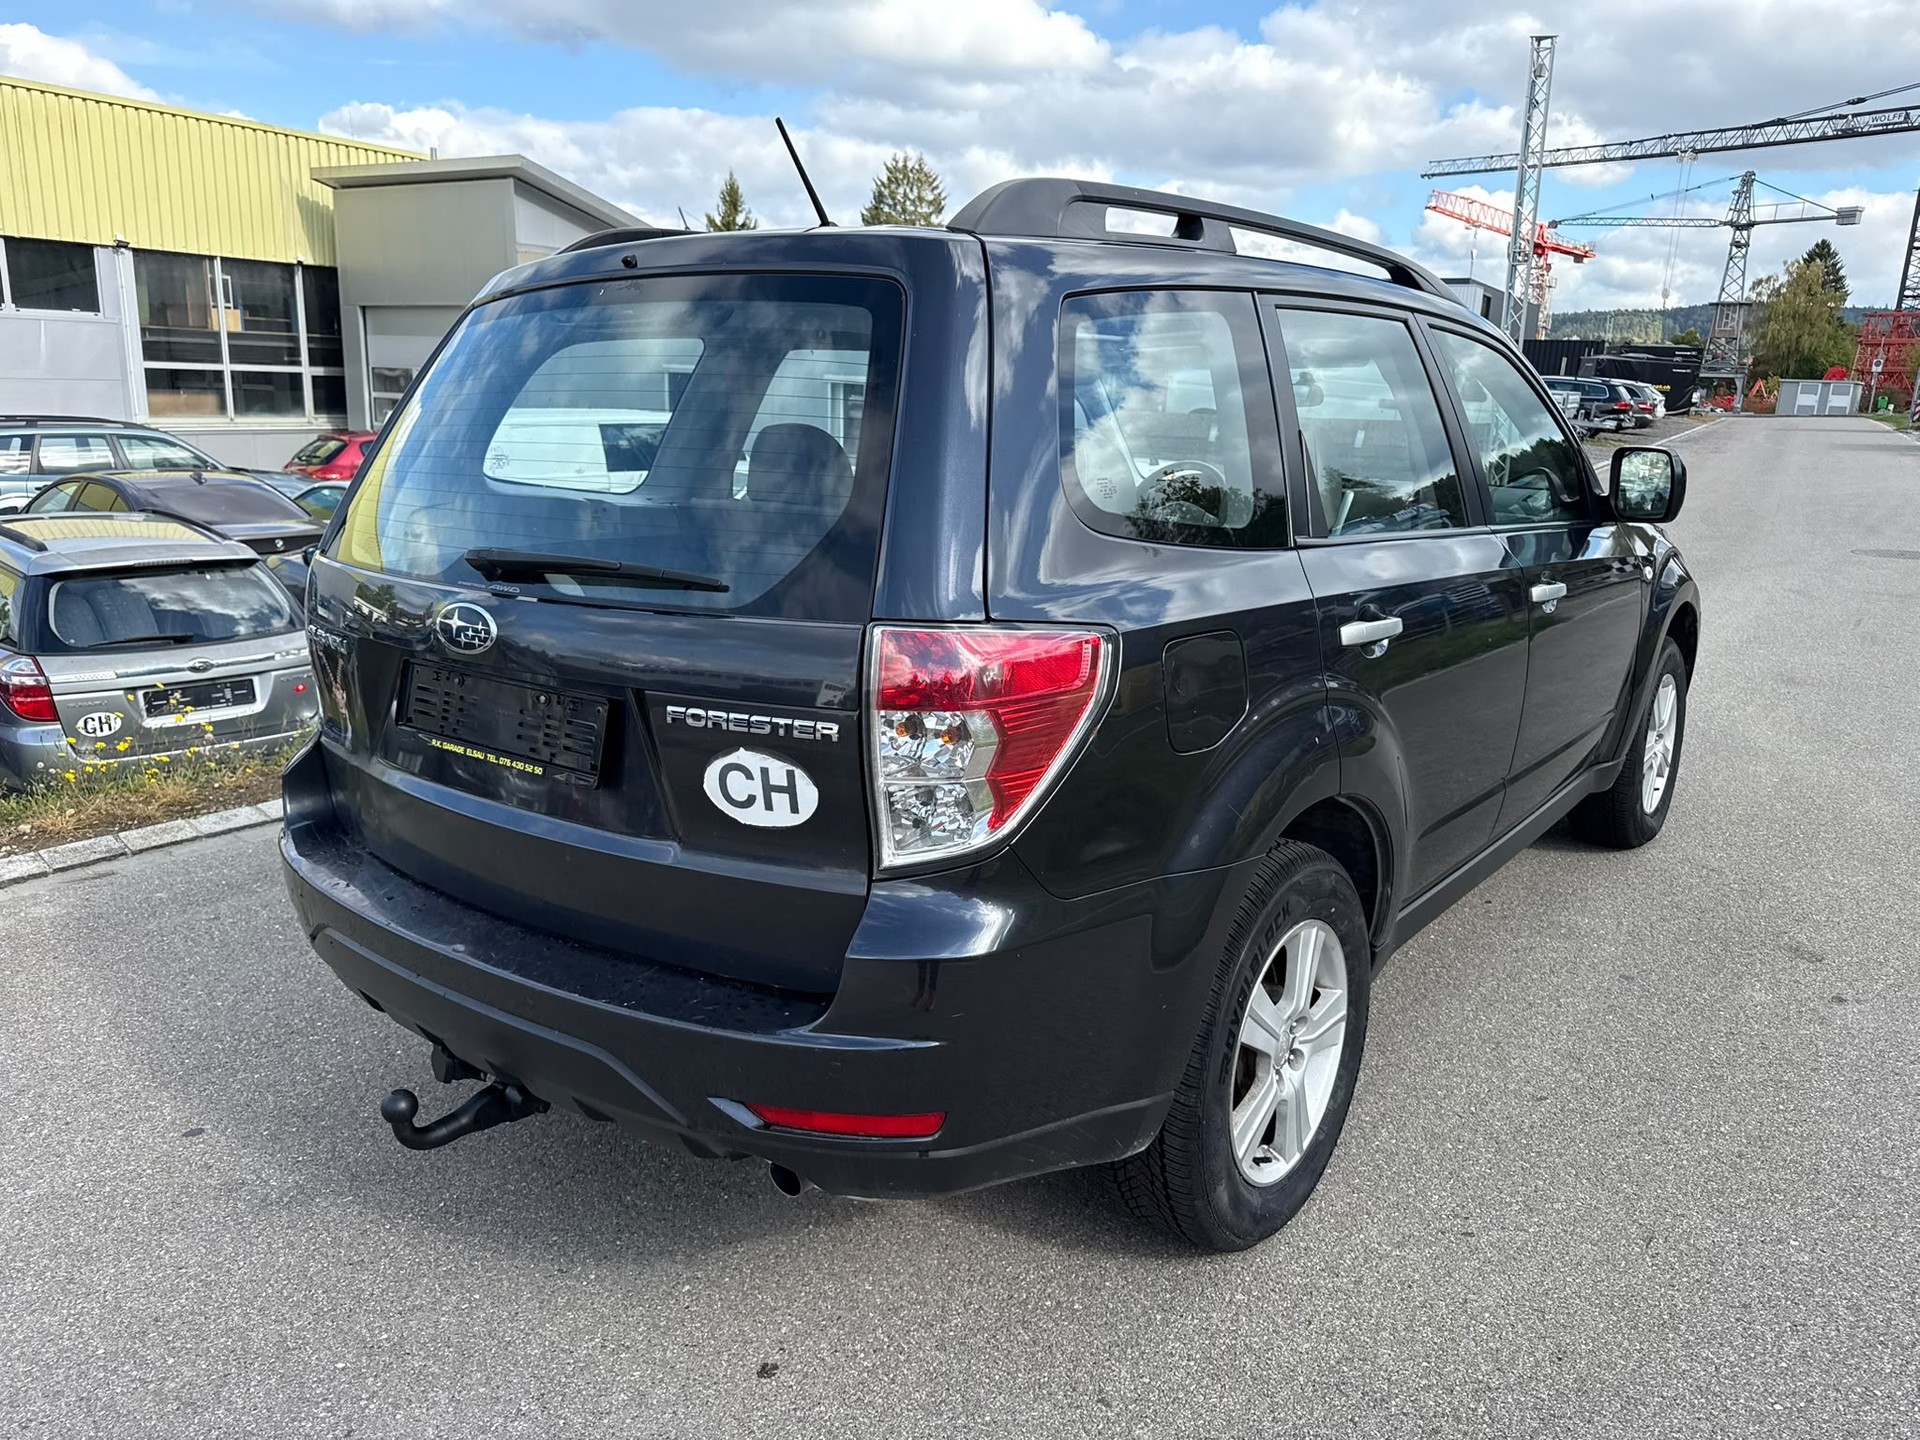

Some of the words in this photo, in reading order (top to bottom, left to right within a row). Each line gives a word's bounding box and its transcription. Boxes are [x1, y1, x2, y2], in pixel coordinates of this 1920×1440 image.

[1871, 112, 1905, 123] WOLFF
[487, 583, 520, 593] AWD
[84, 715, 112, 735] CH
[666, 705, 840, 742] FORESTER
[442, 742, 465, 755] GARAGE
[466, 748, 485, 760] ELSAU
[511, 760, 524, 771] 430
[524, 763, 534, 773] 52
[534, 766, 543, 775] 50
[718, 762, 800, 815] CH
